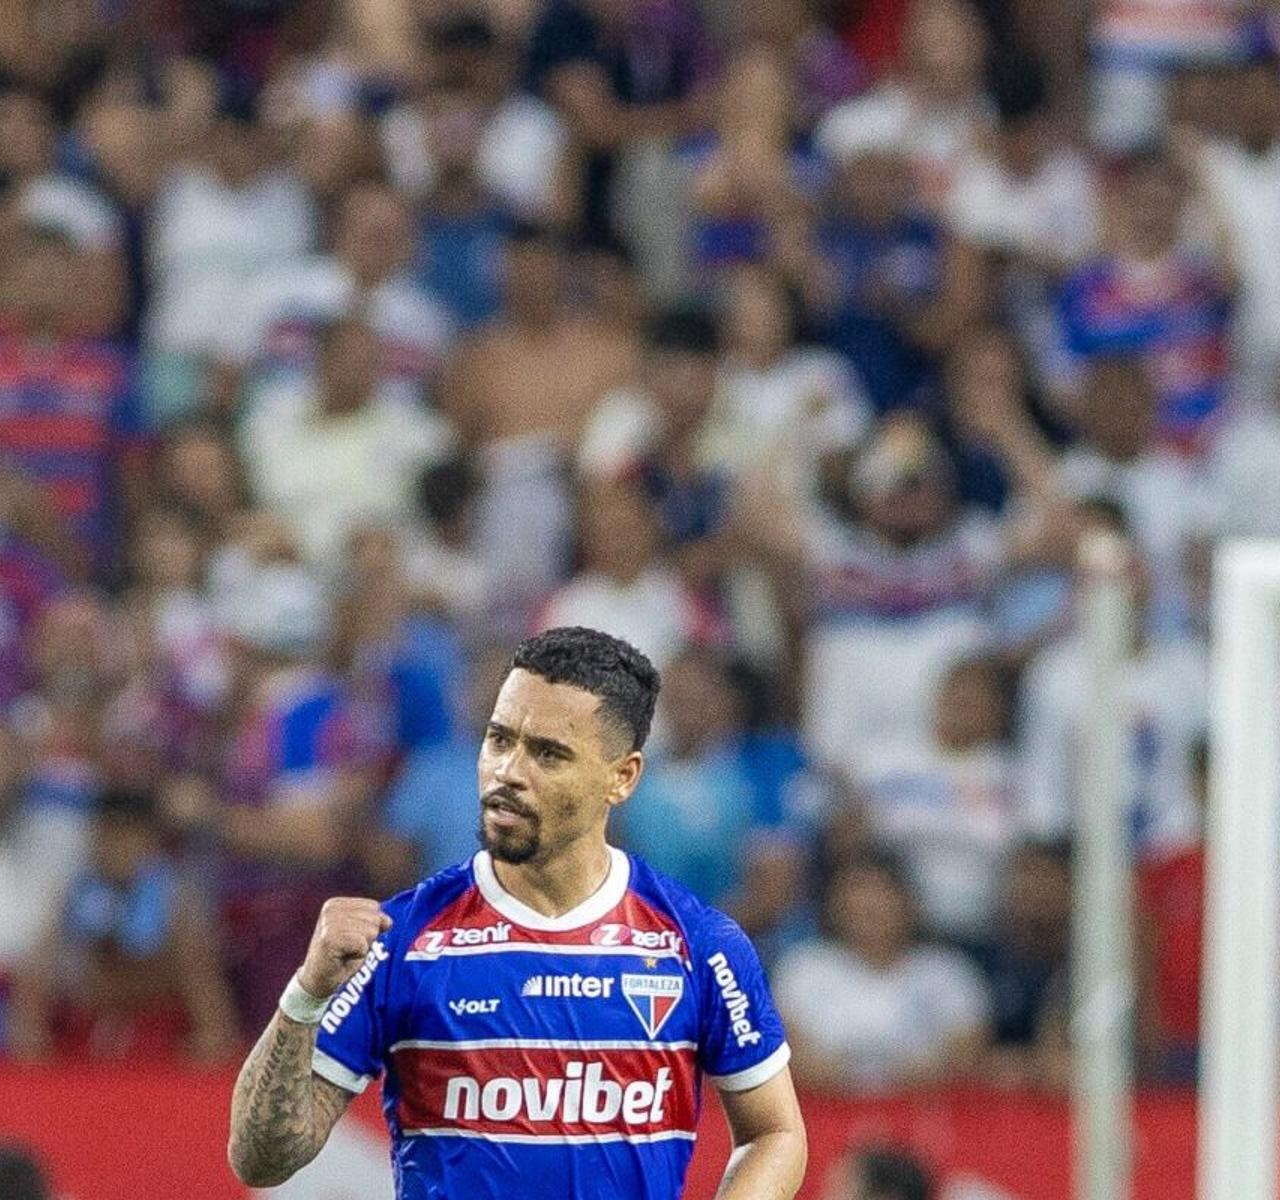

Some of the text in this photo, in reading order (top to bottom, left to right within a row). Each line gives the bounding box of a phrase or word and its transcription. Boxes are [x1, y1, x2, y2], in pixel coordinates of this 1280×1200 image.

[451, 921, 512, 945] zenir
[544, 972, 615, 998] inter
[449, 998, 501, 1016] VOLT
[707, 952, 762, 1048] novibet
[443, 1061, 672, 1125] novibet
